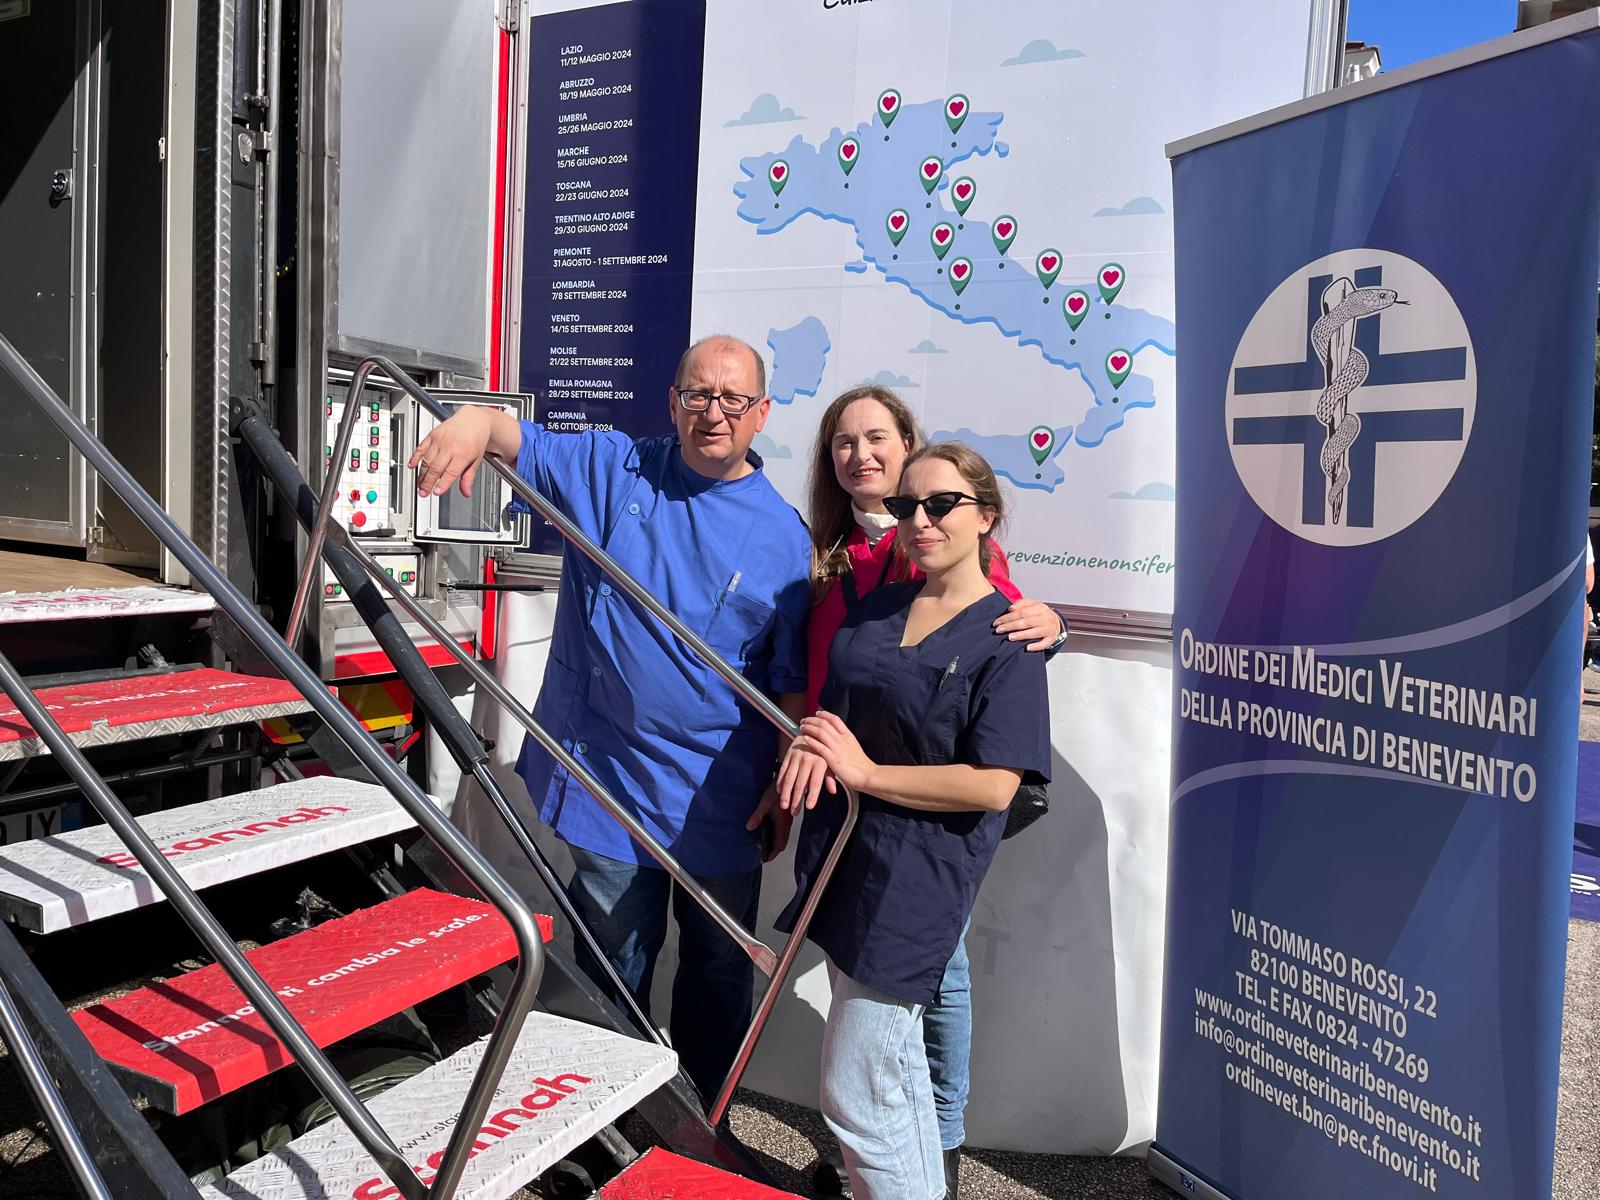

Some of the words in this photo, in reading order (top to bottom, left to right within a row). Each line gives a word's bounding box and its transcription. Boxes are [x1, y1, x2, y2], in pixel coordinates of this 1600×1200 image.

[561, 45, 583, 55] LAZIO
[561, 56, 578, 66] 11/12
[579, 53, 611, 65] MAGGIO
[612, 50, 632, 60] 2024
[560, 78, 594, 89] ABRUZZO
[560, 90, 578, 101] 18/19
[580, 87, 611, 98] MAGGIO
[612, 85, 632, 94] 2024
[559, 113, 587, 123] UMBRIA
[558, 124, 579, 134] 25/26
[581, 122, 612, 132] MAGGIO
[613, 119, 633, 128] 2024
[558, 147, 589, 157] MARCHE
[557, 158, 575, 168] 15/16
[577, 157, 607, 166] GIUGNO
[608, 155, 628, 164] 2024
[556, 181, 591, 190] TOSCANA
[555, 192, 576, 202] 22/23
[578, 190, 608, 200] GIUGNO
[609, 189, 629, 197] 2024
[555, 214, 591, 223] TRENTINO
[593, 213, 611, 221] ALTO
[612, 211, 635, 220] ADIGE
[554, 226, 576, 235] 29/30
[577, 224, 608, 233] GIUGNO
[609, 223, 628, 231] 2024
[554, 248, 591, 256] PIEMONTE
[603, 256, 646, 265] SETTEMBRE
[647, 255, 667, 264] 2024
[552, 280, 595, 289] LOMBARDIA
[552, 292, 563, 300] 7/8
[564, 291, 606, 299] SETTEMBRE
[608, 291, 626, 299] 2024
[551, 325, 569, 333] 14/15
[570, 325, 612, 333] SETTEMBRE
[550, 347, 577, 355] MOLISE
[550, 358, 569, 366] 21/22
[570, 358, 612, 366] SETTEMBRE
[614, 358, 633, 366] 2024
[549, 380, 573, 388] EMILIA
[574, 380, 612, 388] ROMAGNA
[549, 390, 569, 398] 28/29
[570, 391, 612, 399] SETTEMBRE
[614, 391, 633, 399] 2024
[548, 412, 586, 420] CAMPANIA
[548, 422, 559, 430] 5/6
[561, 423, 593, 431] OTTOBRE
[1181, 688, 1232, 729] DELLA
[1237, 700, 1346, 757] PROVINCIA
[1353, 726, 1376, 764] DI
[1383, 732, 1537, 803] BENEVENTO
[96, 806, 350, 868] Sannah
[1231, 909, 1258, 942] VIA
[1260, 920, 1347, 978] TOMMASO
[1351, 957, 1409, 1009] ROSSI,
[1414, 984, 1438, 1019] 22
[143, 1001, 256, 1053] Stanna
[307, 945, 401, 987] cambia
[399, 936, 427, 952] le
[428, 911, 489, 938] scale.
[1250, 949, 1298, 990] 82100
[1302, 968, 1407, 1038] BENEVENTO
[1236, 971, 1266, 1006] TEL.
[1270, 988, 1278, 1010] E
[1283, 992, 1312, 1030] FAX
[1316, 1009, 1358, 1050] 0824
[1372, 1038, 1429, 1083] 47269
[1195, 988, 1481, 1147] www.ordineveterinaribenevento.it
[1195, 1012, 1480, 1181] info@ordineveterinaribenevento.it
[1226, 1061, 1437, 1192] ordinevet.bn@pec.fnovi.it
